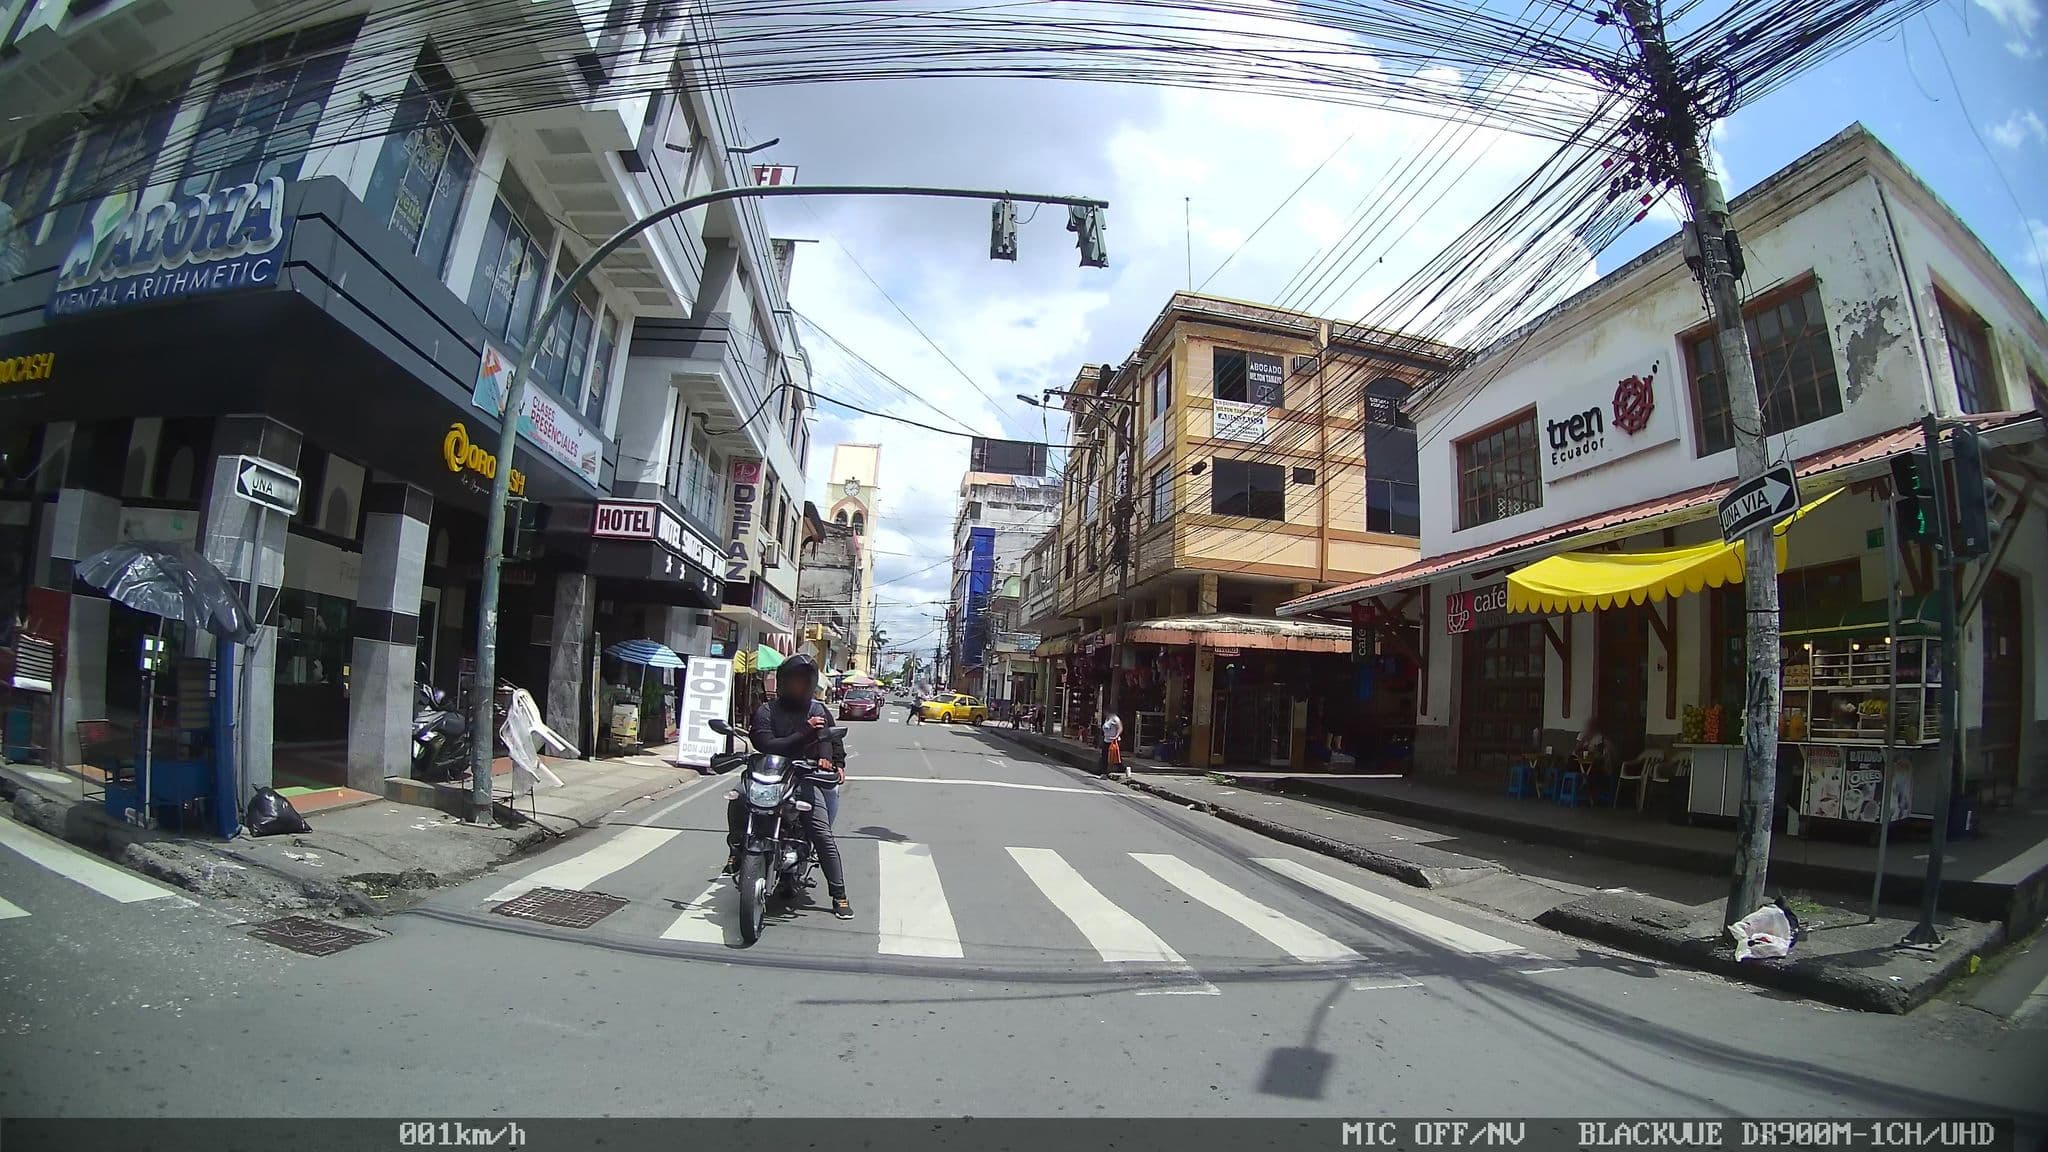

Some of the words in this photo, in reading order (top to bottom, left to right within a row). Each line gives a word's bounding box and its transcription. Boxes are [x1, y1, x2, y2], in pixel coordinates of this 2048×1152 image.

[55, 284, 119, 315] MENTAL
[125, 258, 272, 301] ARITHMETIC
[1249, 360, 1282, 375] ABOGADO
[532, 396, 556, 423] CLASES
[530, 409, 579, 458] PRESENCIALES
[1546, 406, 1604, 450] tren
[1551, 437, 1605, 466] Ecuador
[252, 478, 273, 495] UNA
[599, 509, 650, 532] HOTEL
[1722, 503, 1741, 528] UNA
[1742, 490, 1770, 513] VIA
[1473, 584, 1507, 613] café
[688, 662, 727, 744] HOTEL
[682, 744, 698, 752] DON
[699, 745, 718, 754] JUAN
